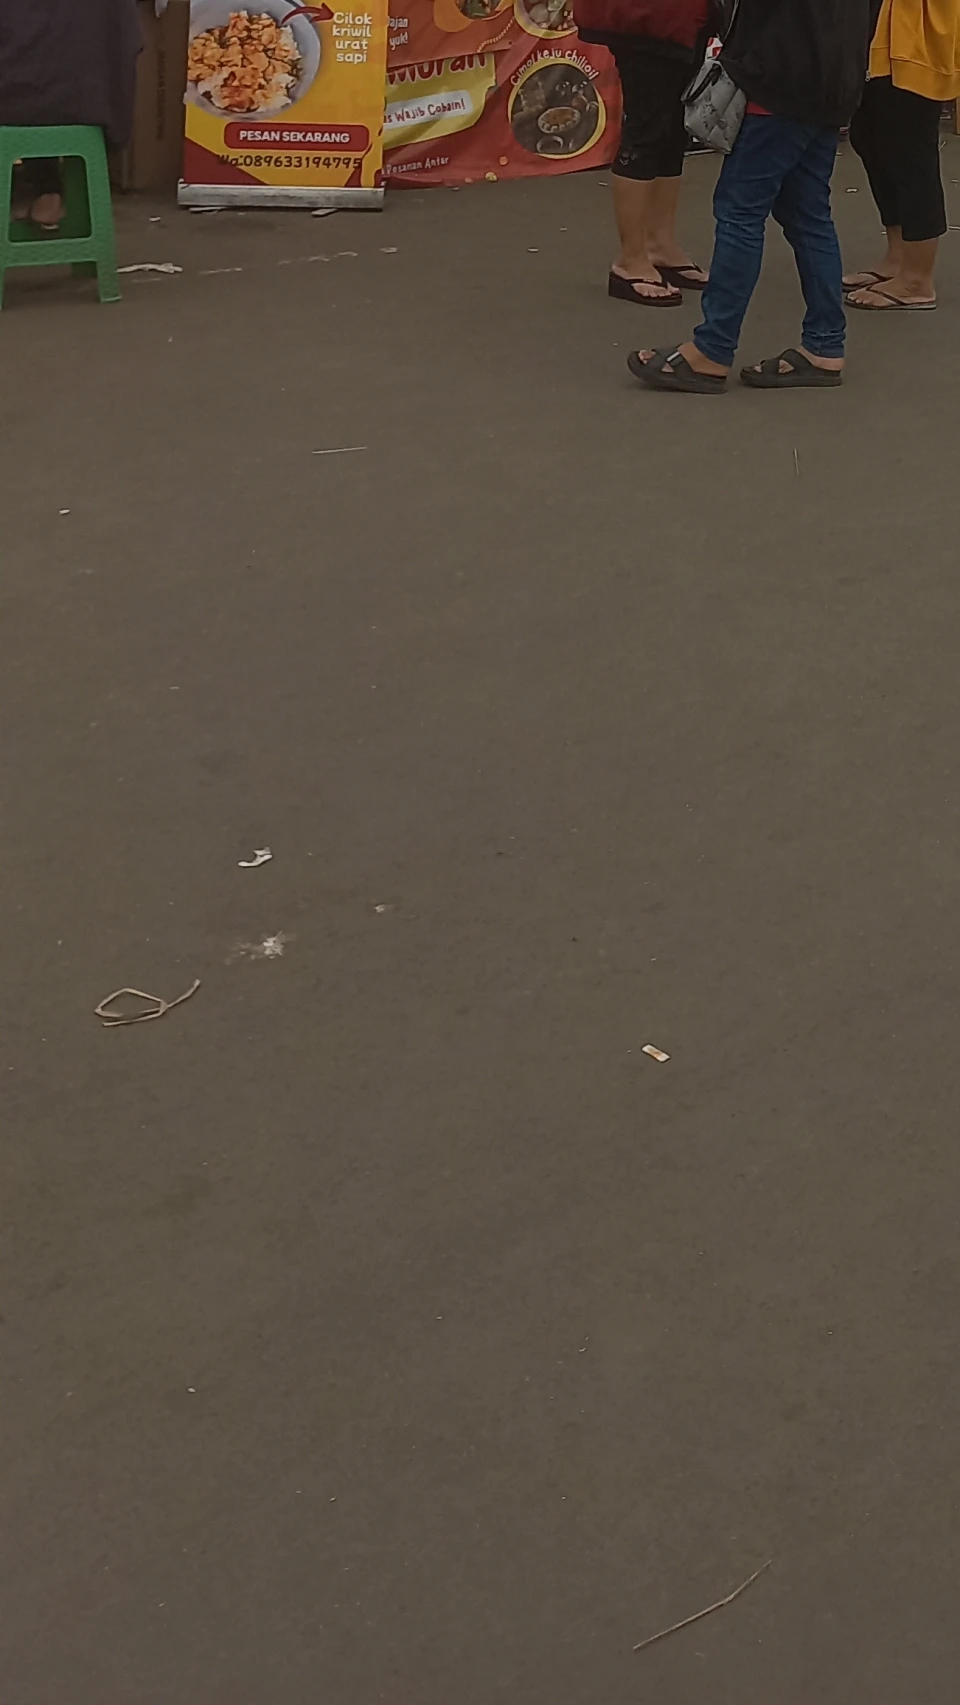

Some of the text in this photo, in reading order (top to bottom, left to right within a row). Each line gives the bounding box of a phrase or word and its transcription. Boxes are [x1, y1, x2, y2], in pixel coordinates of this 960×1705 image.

[333, 11, 372, 26] Cilok
[332, 24, 372, 37] kriwil
[335, 37, 369, 50] urat
[335, 50, 367, 65] sapi
[394, 103, 426, 123] Wajib
[239, 130, 350, 144] PESAN SEKARANG
